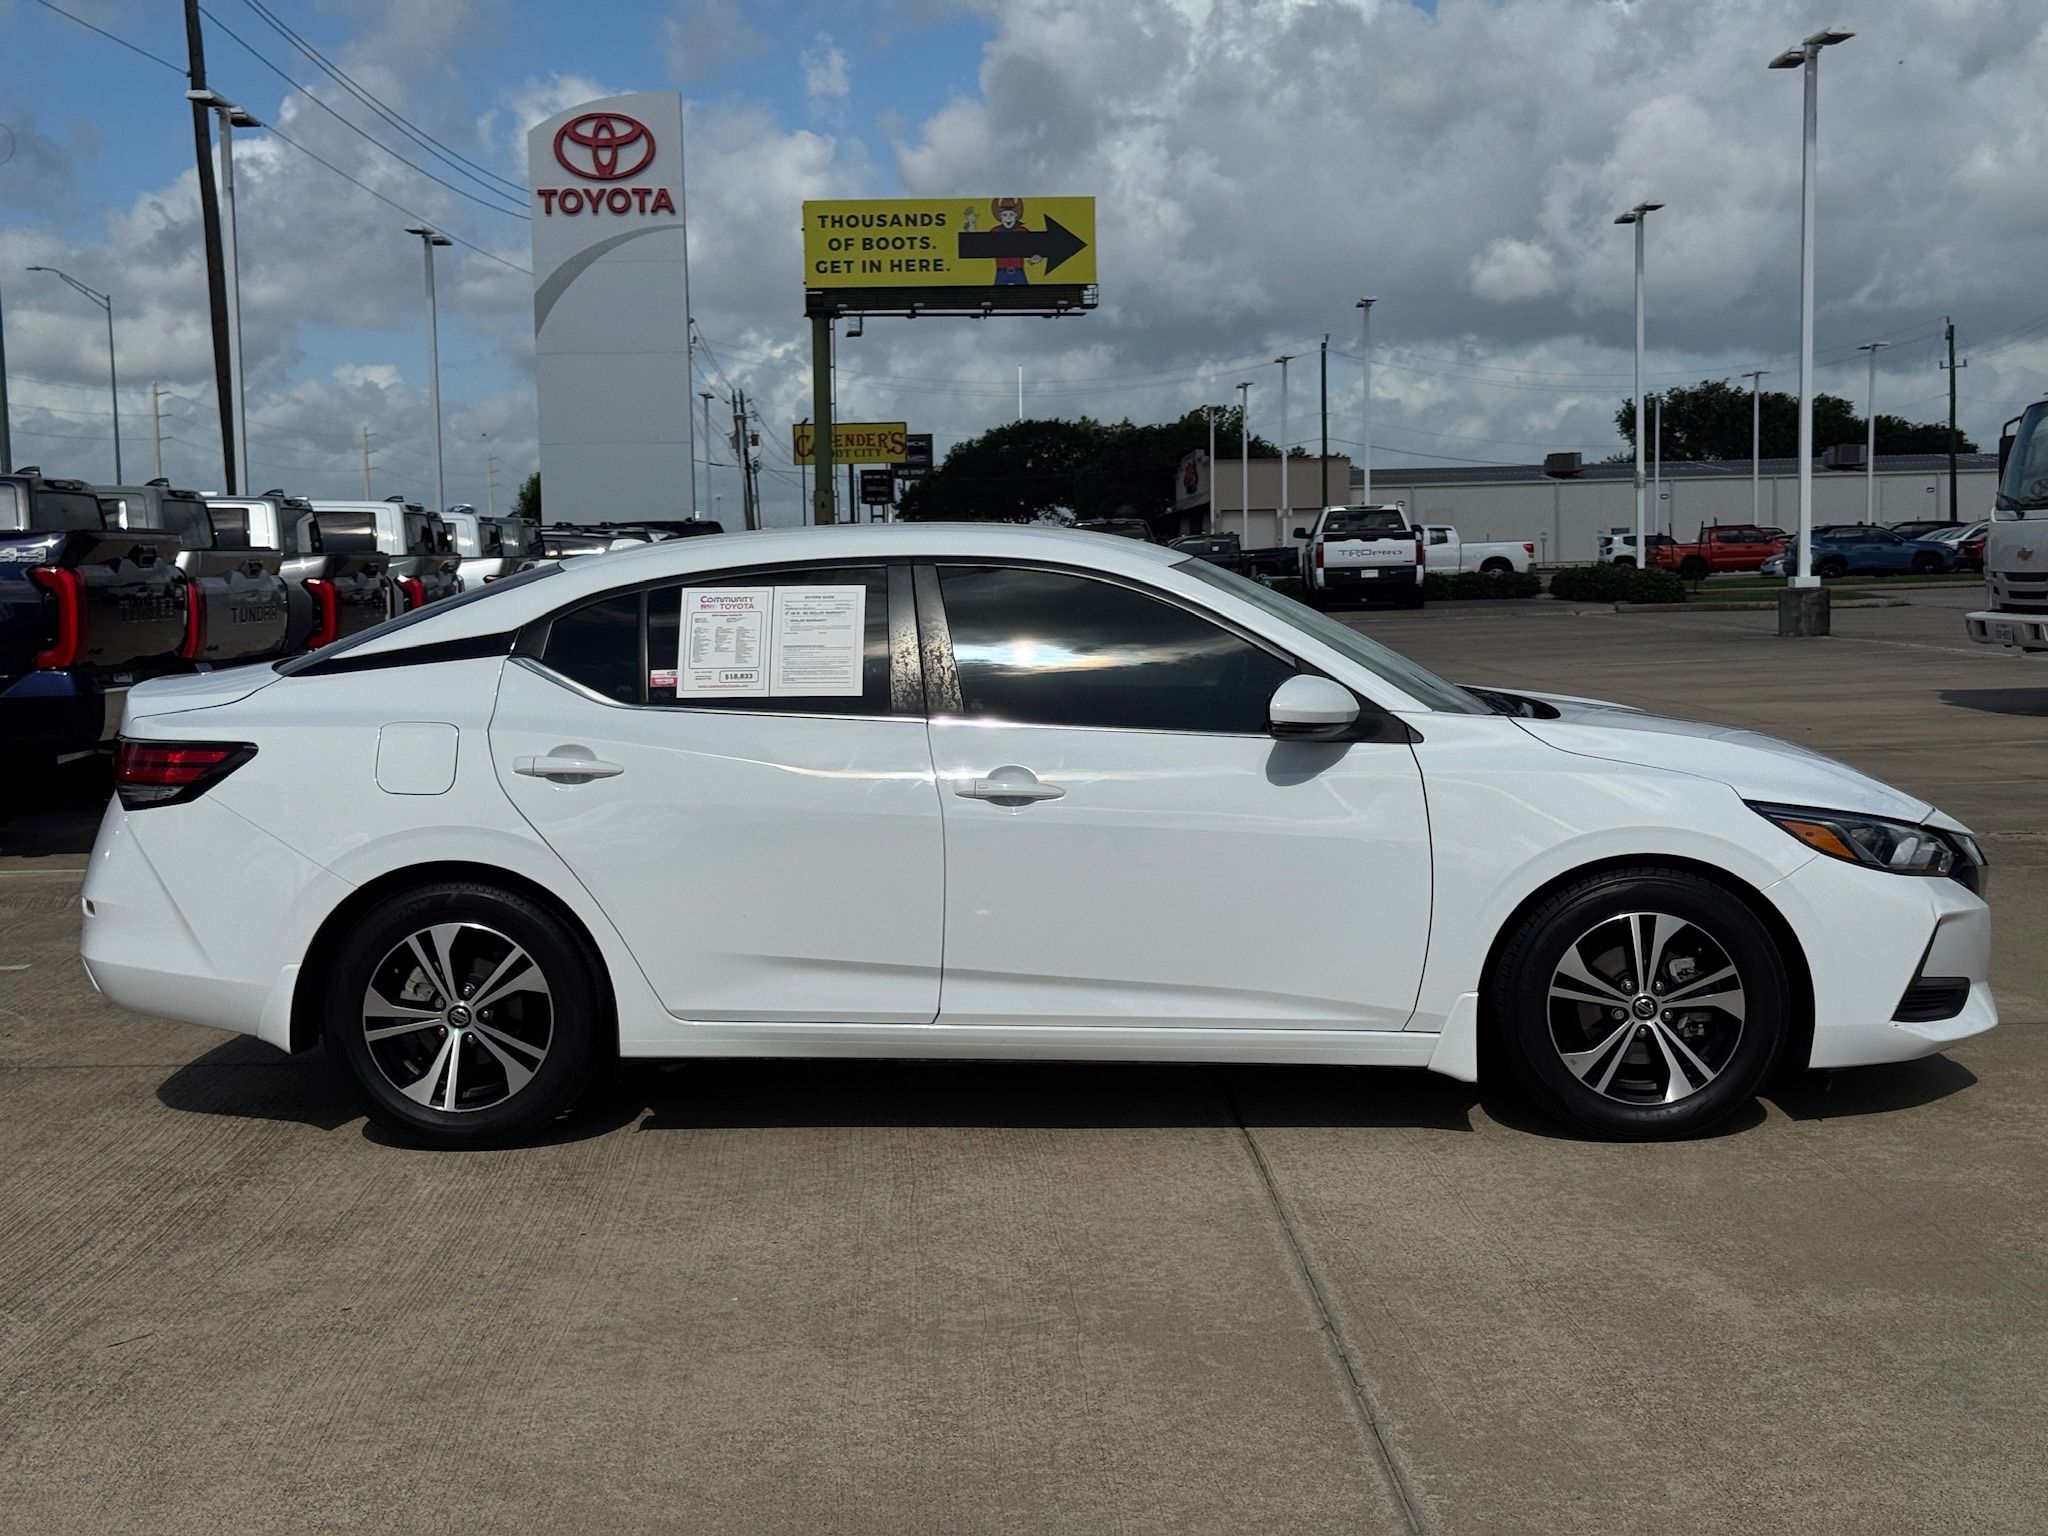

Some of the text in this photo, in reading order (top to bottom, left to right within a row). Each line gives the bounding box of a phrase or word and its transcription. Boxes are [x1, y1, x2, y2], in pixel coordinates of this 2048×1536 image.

[537, 188, 676, 215] TOYOTA
[817, 213, 947, 228] THOUSANDS
[828, 236, 937, 251] OF BOOTS.
[815, 258, 951, 274] GET IN HERE.
[796, 430, 906, 457] CENDER'S
[854, 448, 882, 457] CITY
[230, 605, 277, 623] TUNDRA
